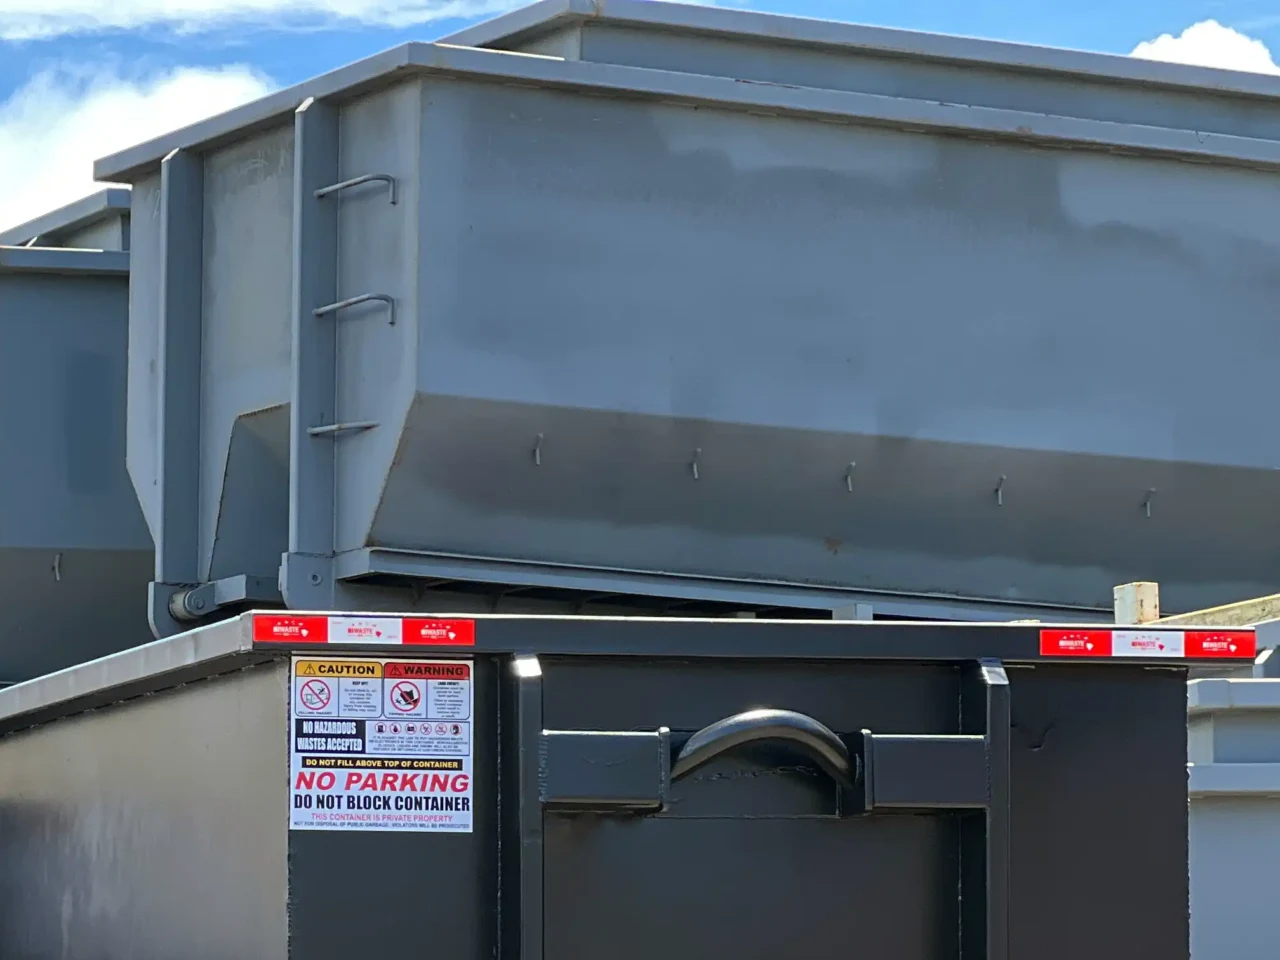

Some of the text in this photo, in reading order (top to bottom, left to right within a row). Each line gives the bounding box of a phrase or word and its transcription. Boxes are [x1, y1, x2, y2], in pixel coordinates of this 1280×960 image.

[318, 665, 375, 674] CAUTION
[404, 666, 464, 676] WARNING
[303, 721, 356, 734] NO HAZARDOUS
[297, 738, 326, 750] WASTES
[327, 738, 362, 751] ACCEPTED
[295, 772, 469, 792] NO PARKING
[294, 794, 470, 811] DO NOT BLOCK CONTAINER
